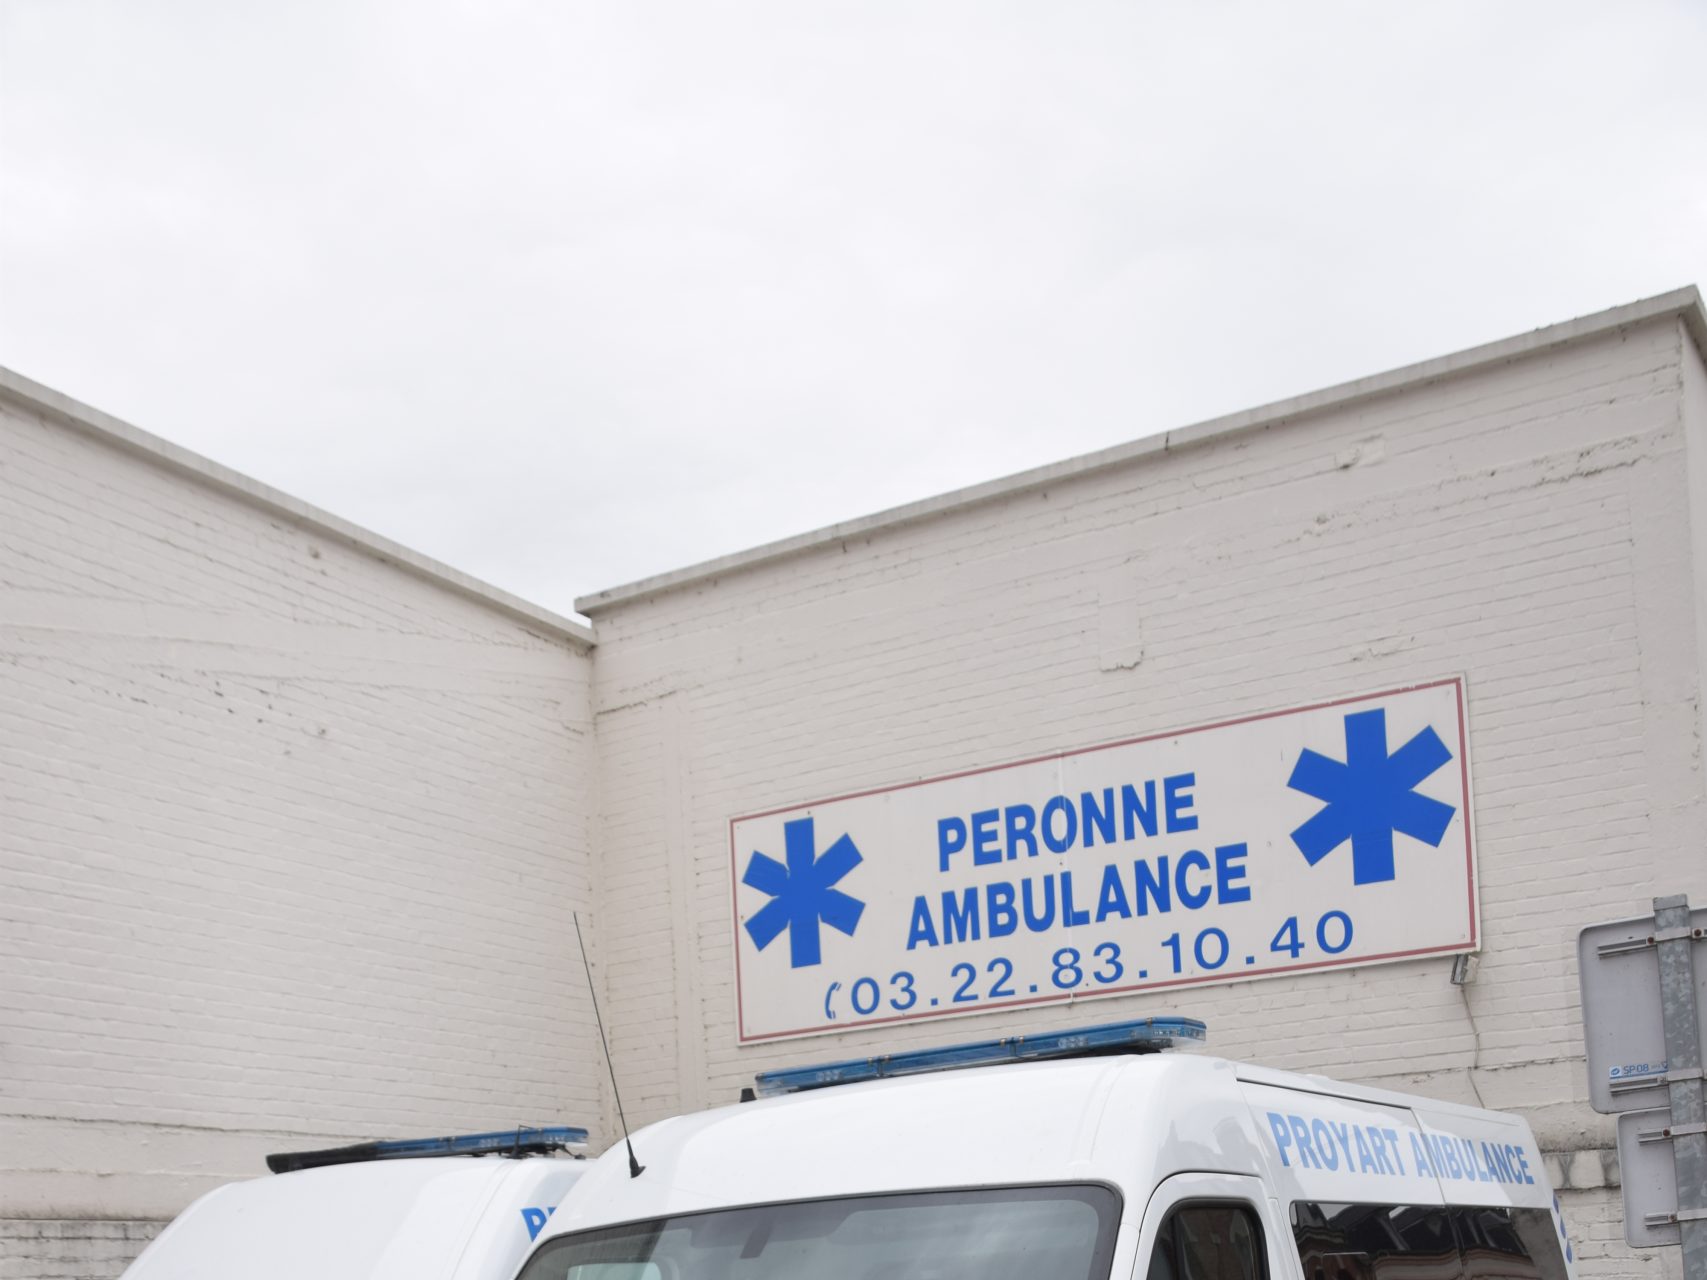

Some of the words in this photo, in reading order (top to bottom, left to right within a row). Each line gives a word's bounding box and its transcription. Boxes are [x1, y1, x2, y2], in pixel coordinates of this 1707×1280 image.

[937, 772, 1199, 872] PERONNE
[906, 842, 1251, 950] AMBULANCE
[1266, 1111, 1406, 1176] PROYART
[1408, 1131, 1535, 1185] AMBULANCE
